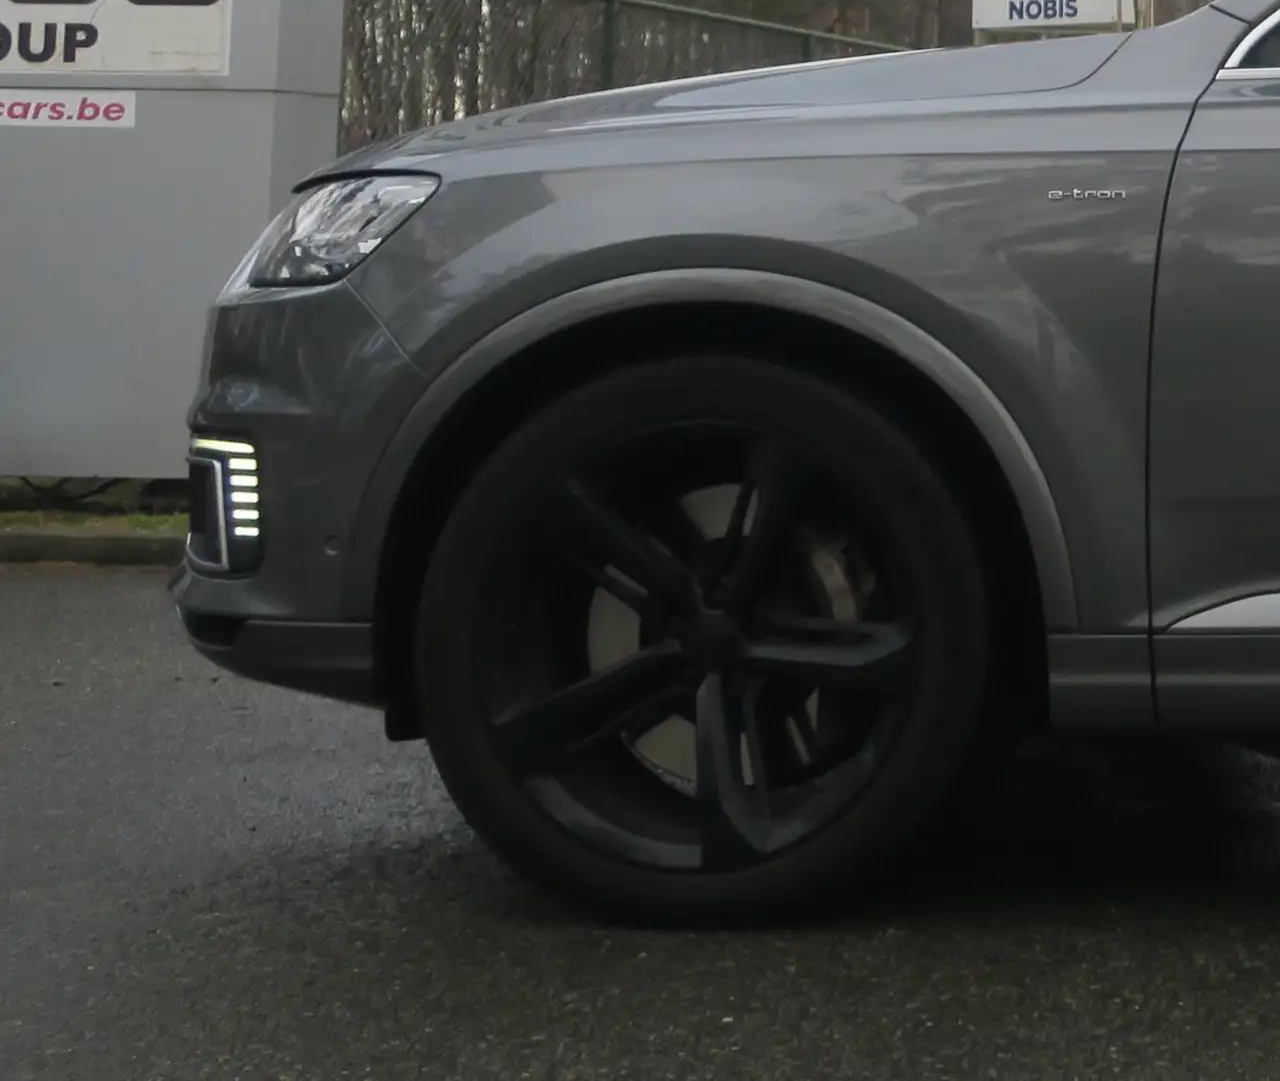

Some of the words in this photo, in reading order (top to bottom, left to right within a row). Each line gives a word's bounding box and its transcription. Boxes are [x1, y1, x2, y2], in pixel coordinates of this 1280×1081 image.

[0, 22, 98, 63] UP
[0, 97, 125, 122] ars.be
[1048, 188, 1126, 199] e-tron
